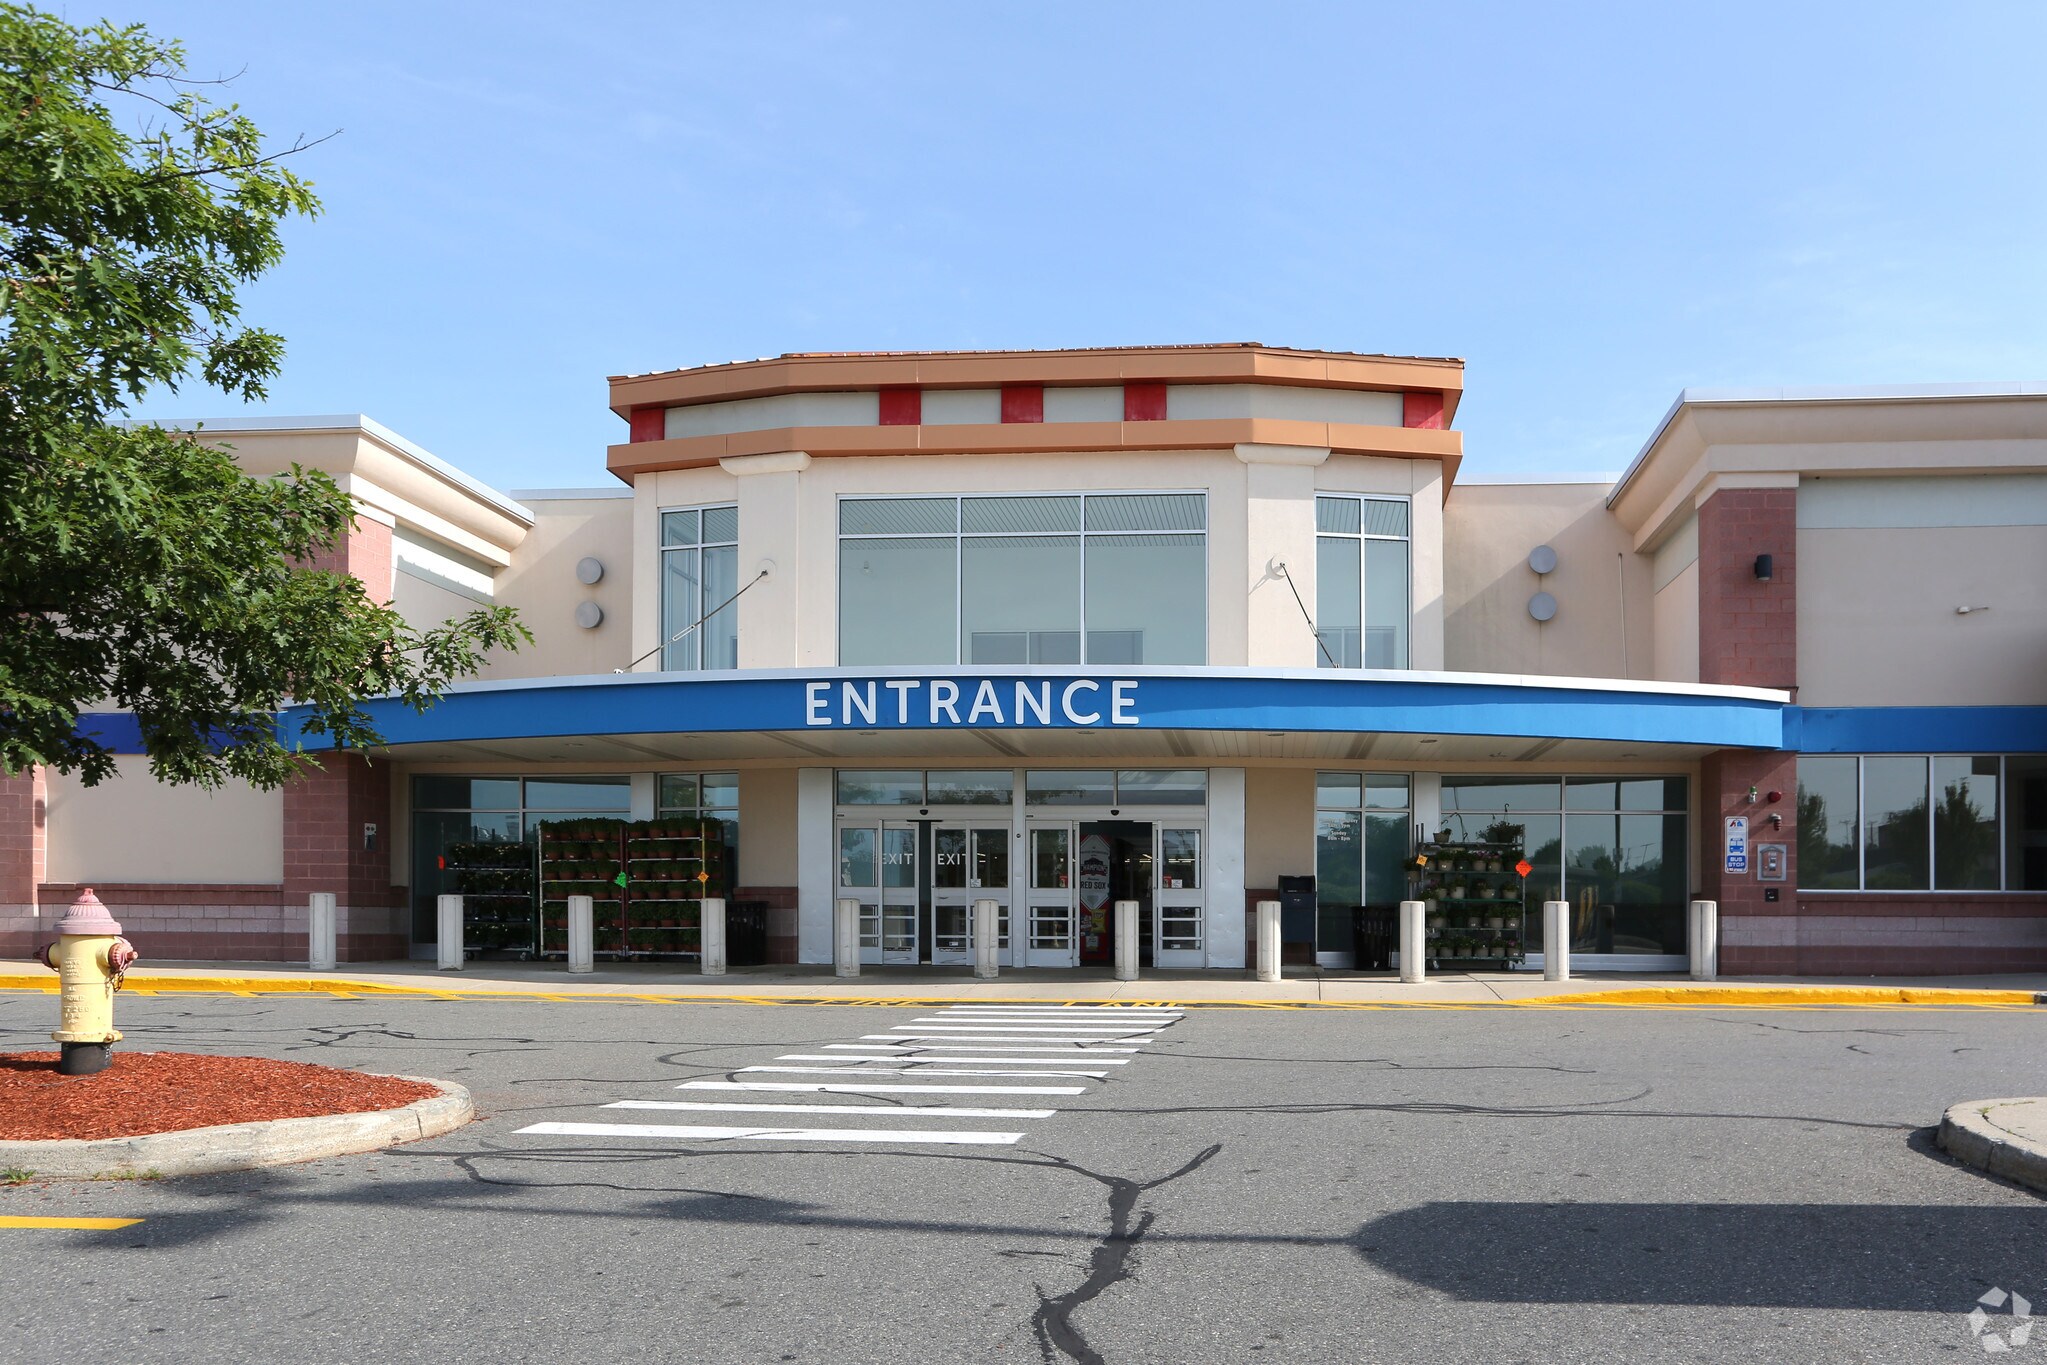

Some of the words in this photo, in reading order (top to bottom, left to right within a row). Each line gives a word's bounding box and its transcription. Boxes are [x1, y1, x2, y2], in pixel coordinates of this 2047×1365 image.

[805, 679, 1140, 726] ENTRANCE
[882, 853, 914, 865] EXIT
[1080, 881, 1092, 889] RED
[1094, 881, 1106, 890] SOX
